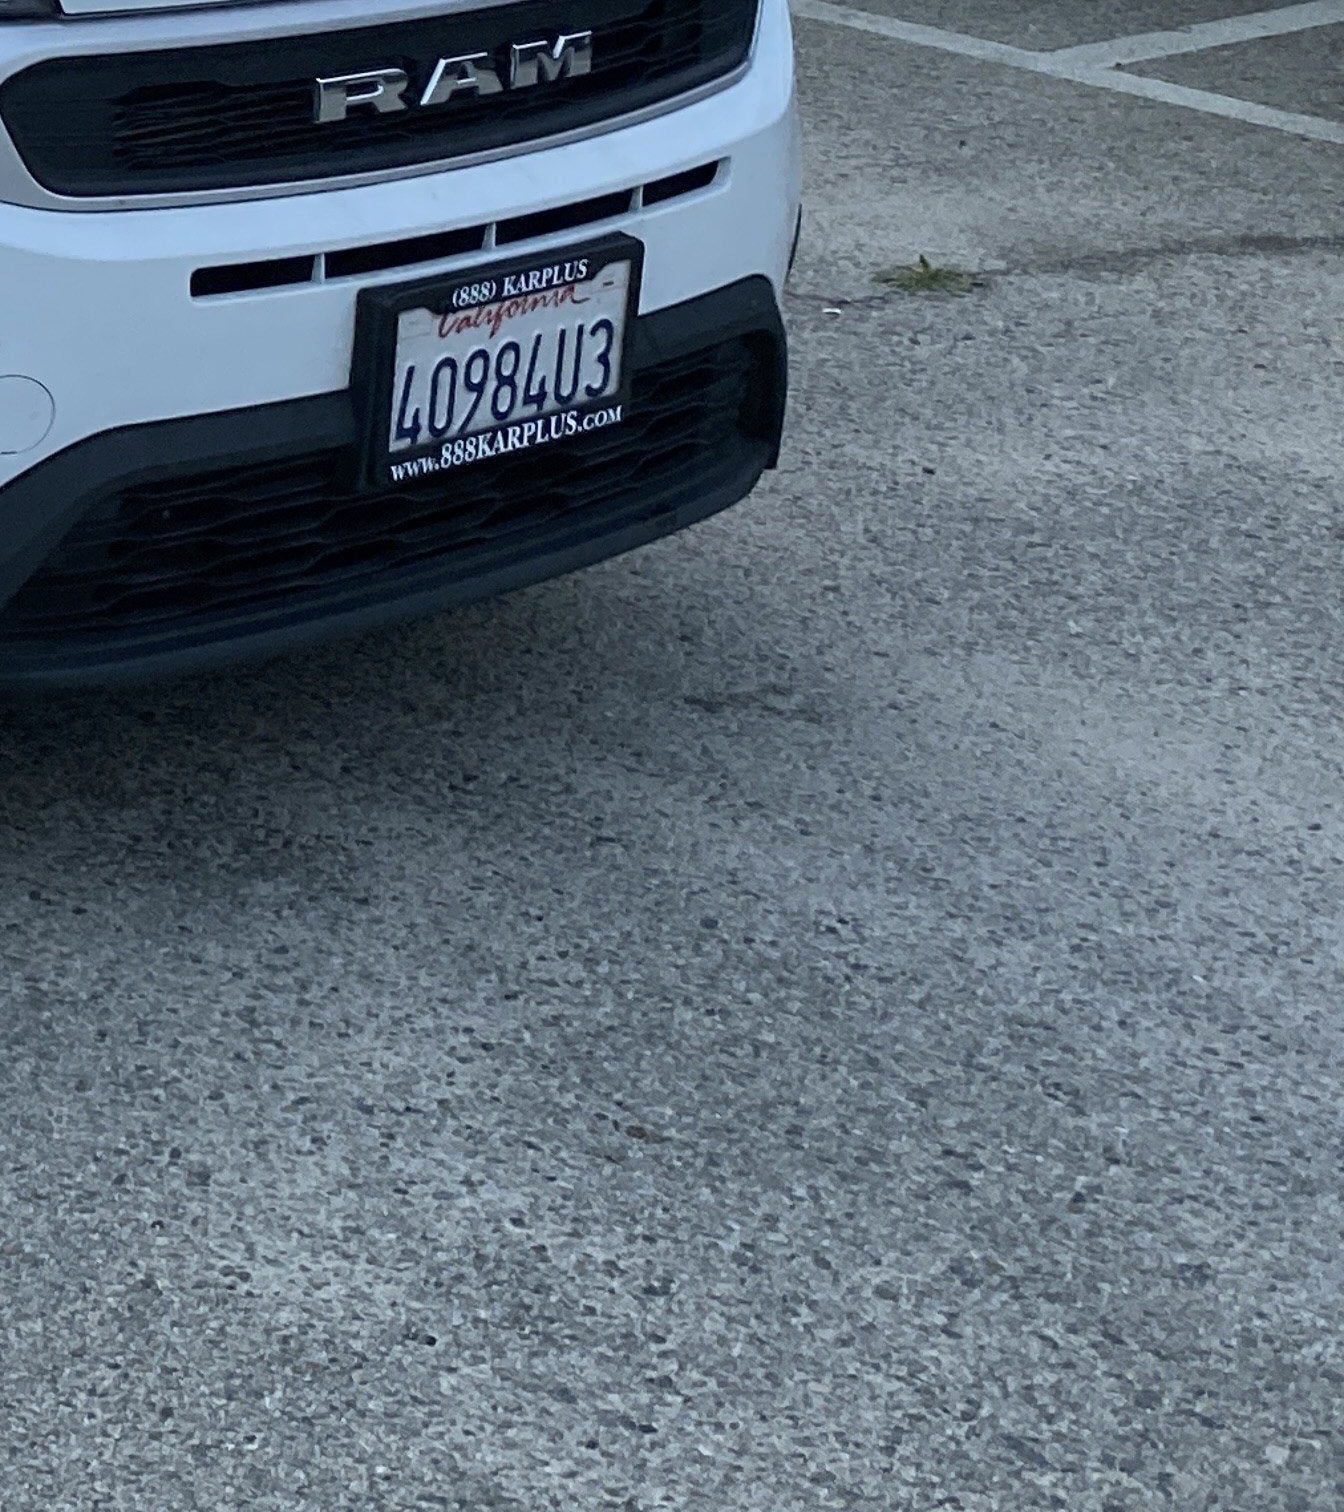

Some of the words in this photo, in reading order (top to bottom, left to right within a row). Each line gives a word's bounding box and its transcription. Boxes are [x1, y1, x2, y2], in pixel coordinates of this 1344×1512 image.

[315, 30, 592, 124] RAM
[436, 283, 590, 339] California
[451, 281, 497, 308] (888)
[501, 258, 590, 297] KARPLUS
[393, 318, 614, 446] 40984U3
